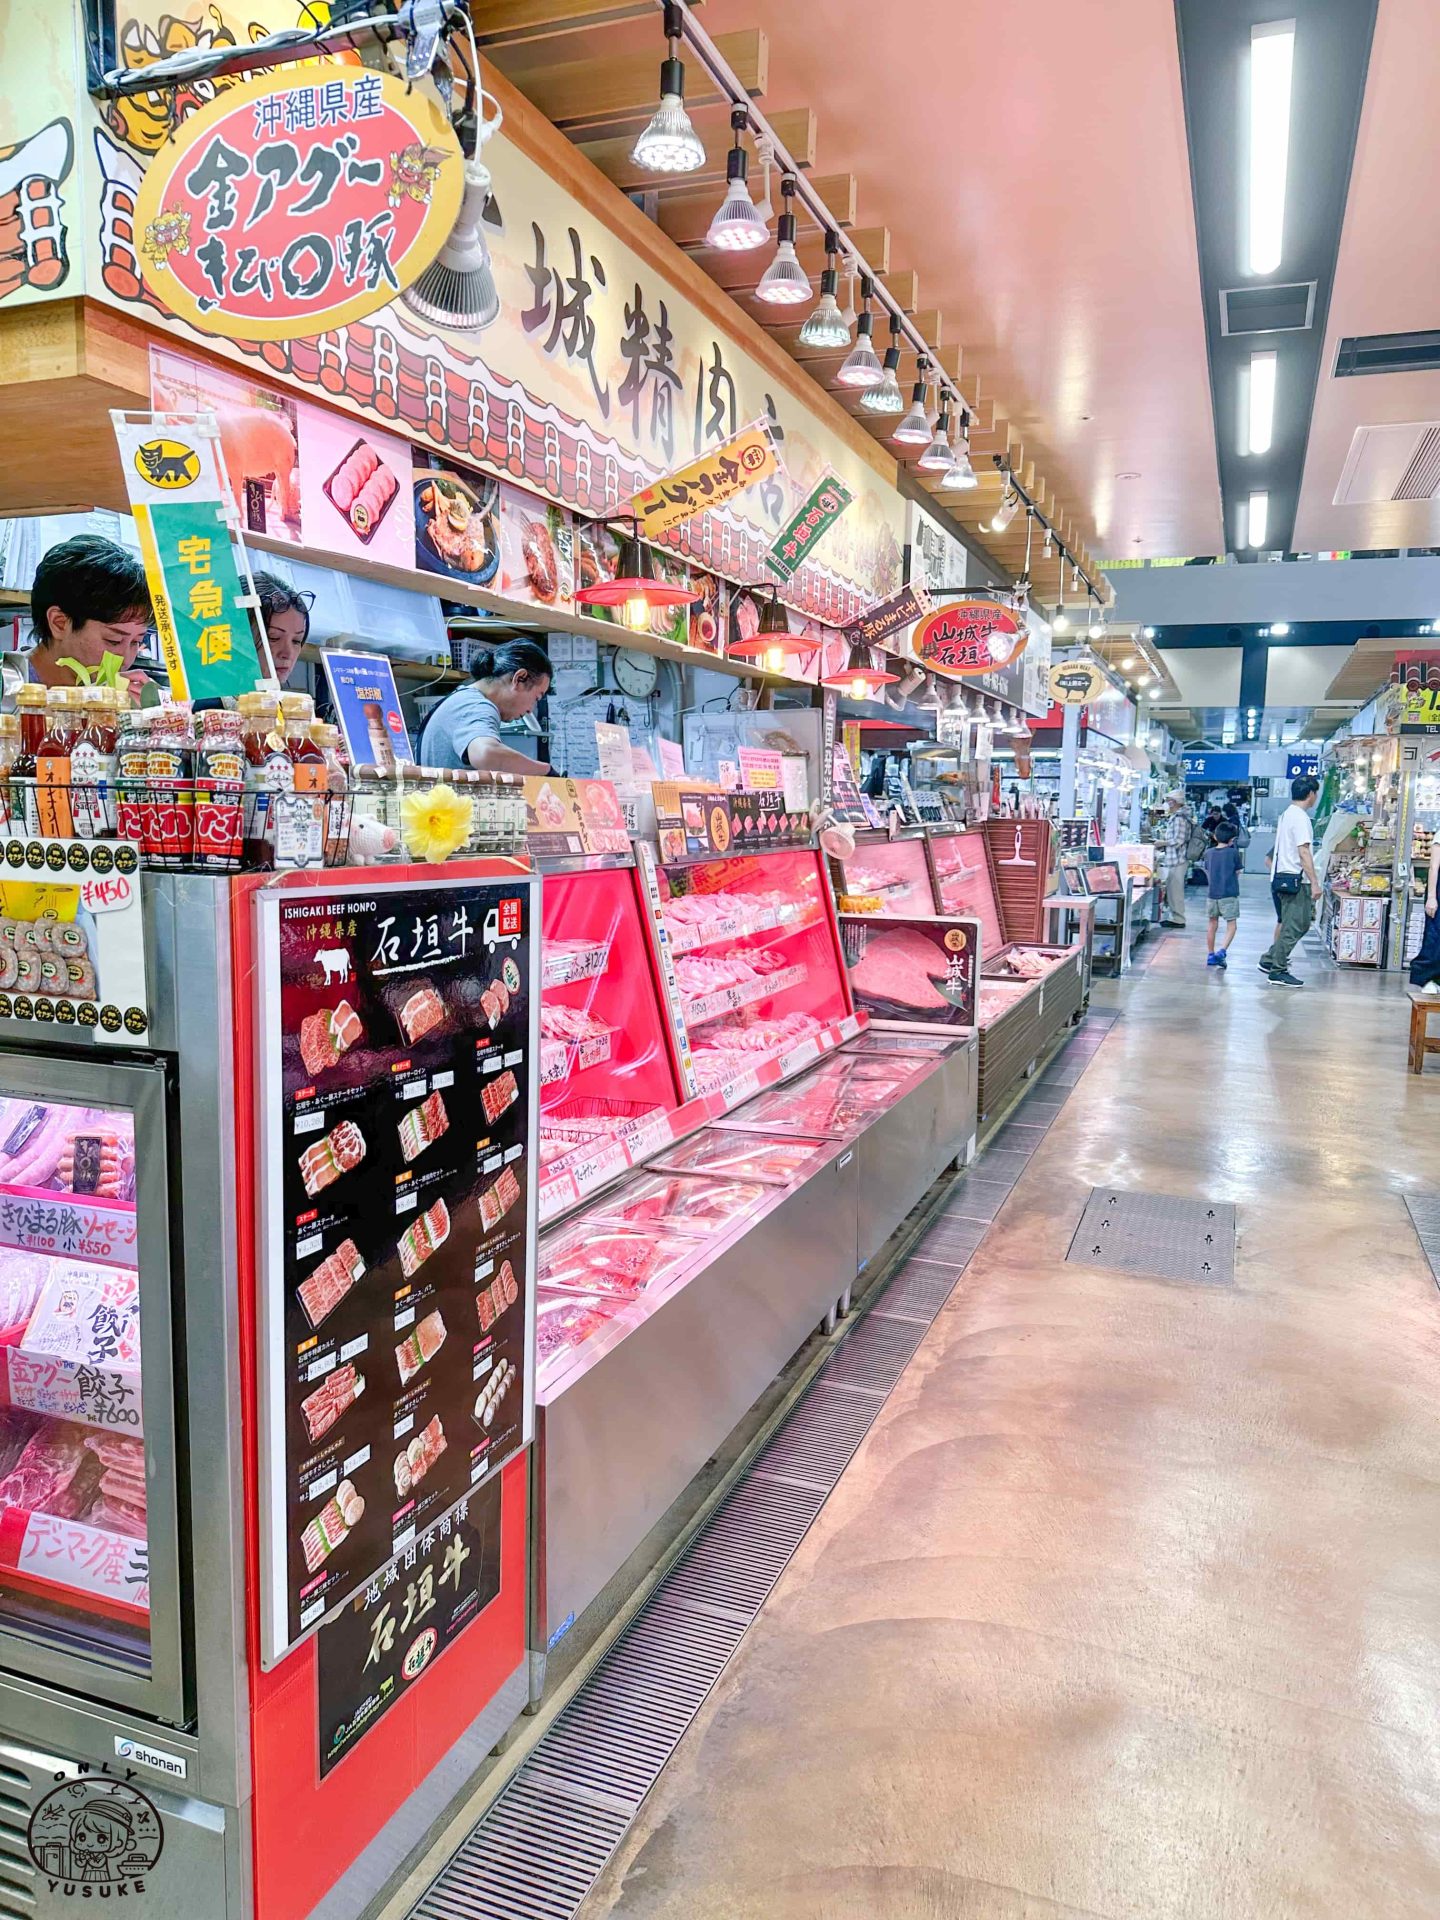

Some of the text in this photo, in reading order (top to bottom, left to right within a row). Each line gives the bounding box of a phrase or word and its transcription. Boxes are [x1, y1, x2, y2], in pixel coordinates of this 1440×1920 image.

[254, 75, 383, 138] 沖縄県産
[187, 134, 382, 231] 金アグー
[782, 506, 825, 560] 石垣牛
[178, 535, 233, 666] 宅急便
[958, 608, 1002, 621] 沖縄県産
[154, 594, 177, 671] 発送承ります
[1425, 724, 1439, 733] TEL
[83, 876, 131, 908] ¥450
[284, 901, 377, 919] ISHIGAKI BEEF HONPO
[502, 902, 519, 915] 全国
[305, 919, 359, 941] 沖縄県産
[371, 906, 474, 964] 石垣牛
[502, 917, 519, 931] 配送
[943, 954, 968, 995] 山城牛
[73, 1364, 135, 1404] 餃子
[25, 1519, 129, 1586] デンマーク産
[362, 1532, 471, 1674] 石垣牛
[135, 1749, 182, 1775] shonan
